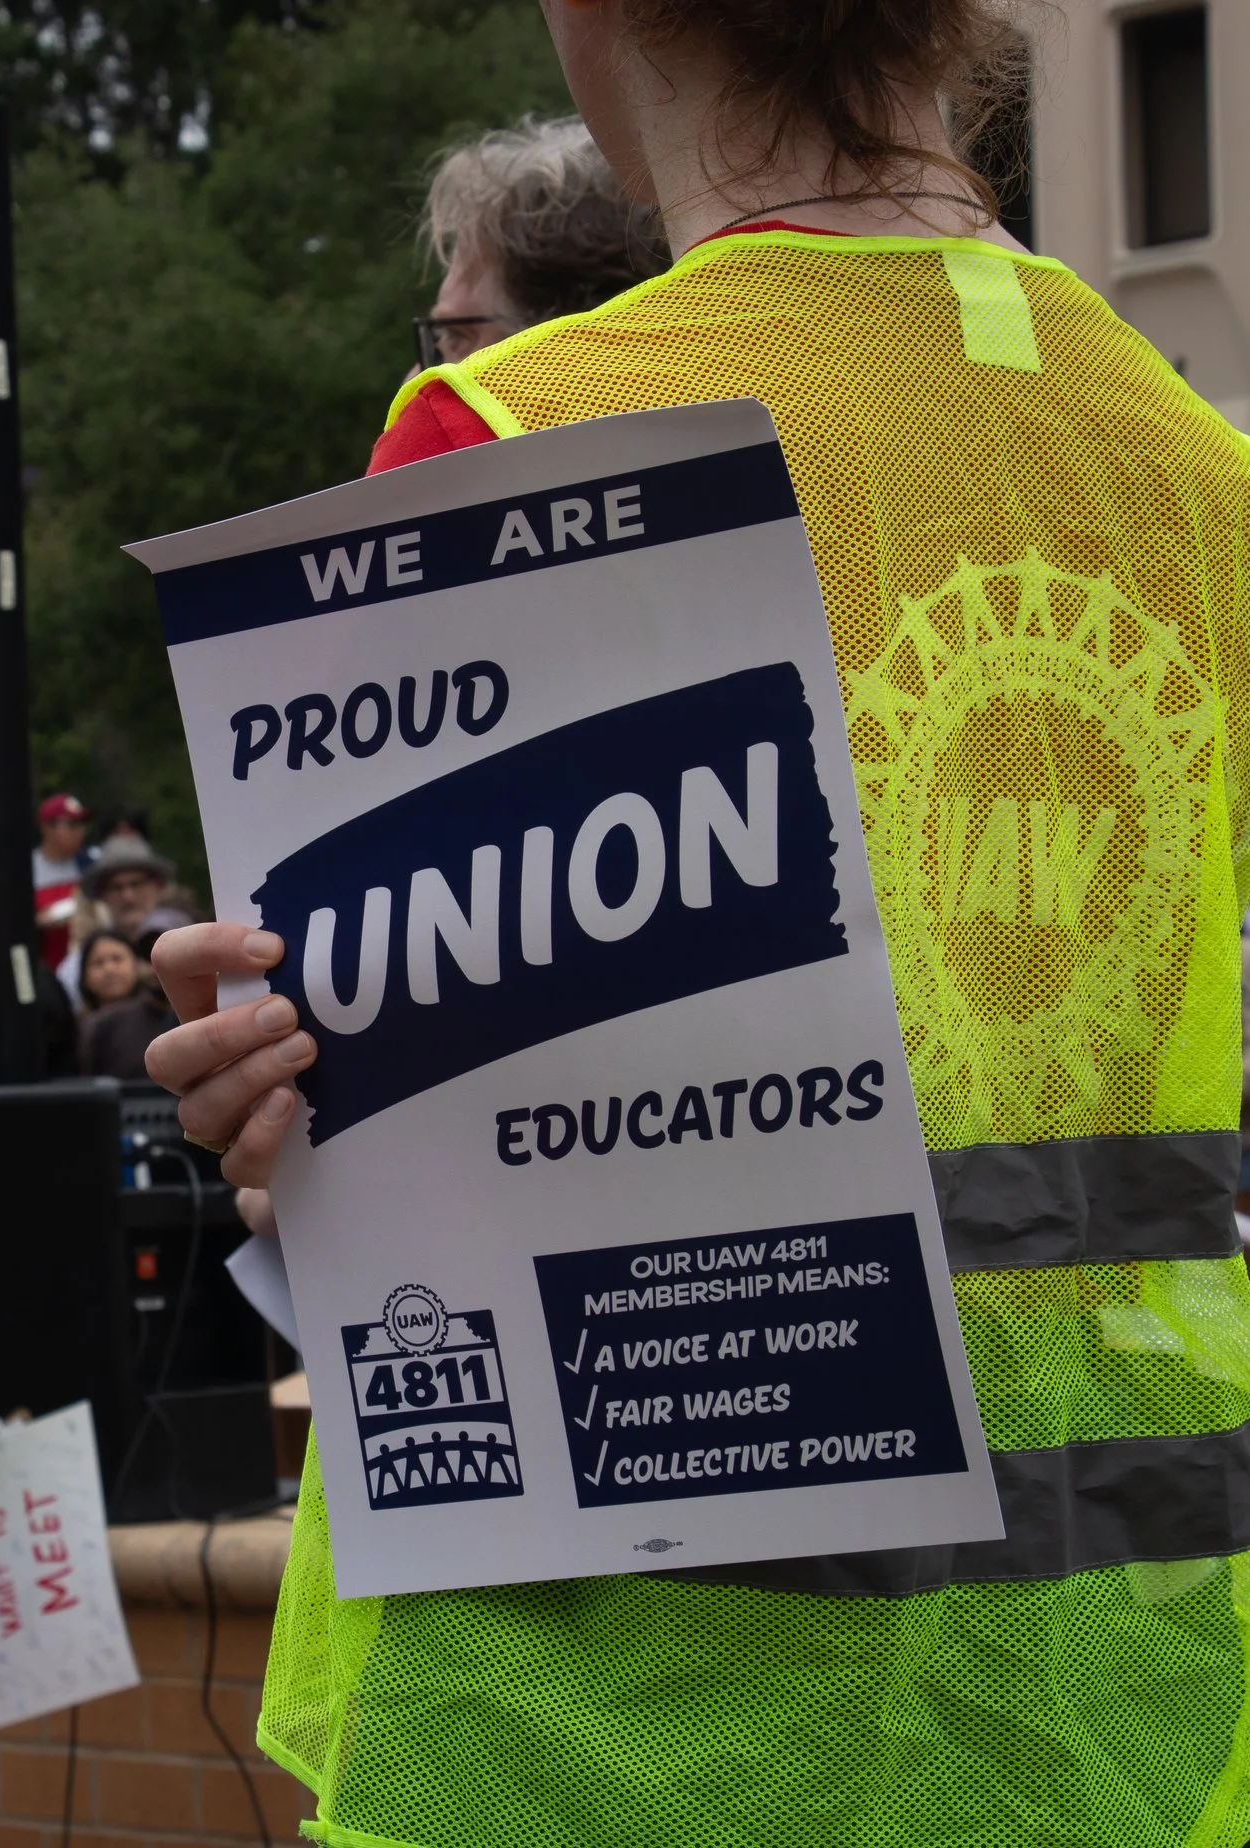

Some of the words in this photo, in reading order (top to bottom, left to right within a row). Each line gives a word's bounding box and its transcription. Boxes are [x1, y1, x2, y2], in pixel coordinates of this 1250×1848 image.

[300, 531, 424, 602] WE
[490, 485, 647, 565] ARE
[230, 660, 509, 780] PROUD
[303, 742, 779, 1036] UNION
[496, 1059, 885, 1166] EDUCATORS
[630, 1250, 692, 1279] OUR
[697, 1243, 766, 1271] UAW
[771, 1235, 828, 1262] 4811
[584, 1273, 773, 1316] MEMBERSHIP
[778, 1261, 890, 1294] MEANS:
[396, 1312, 433, 1329] UAW
[594, 1345, 616, 1372] A
[622, 1333, 710, 1369] VOICE
[717, 1329, 756, 1359] AT
[764, 1319, 860, 1355] WORK
[365, 1354, 491, 1411] 4811
[605, 1395, 673, 1429] FAIR
[683, 1383, 791, 1420] WAGES
[614, 1441, 790, 1485] COLLECTIVE
[800, 1429, 917, 1467] POWER
[24, 1491, 80, 1616] MEET
